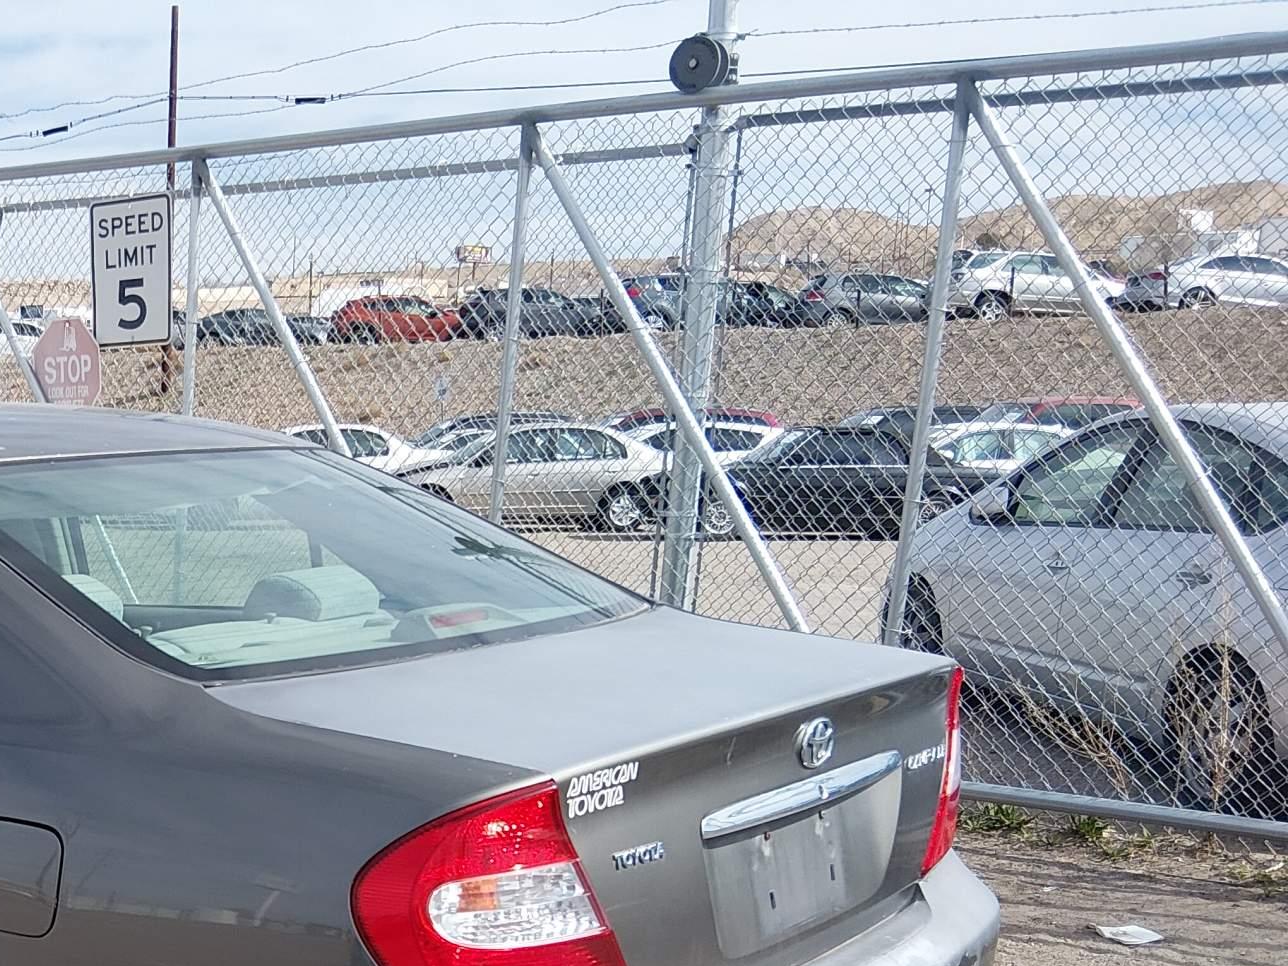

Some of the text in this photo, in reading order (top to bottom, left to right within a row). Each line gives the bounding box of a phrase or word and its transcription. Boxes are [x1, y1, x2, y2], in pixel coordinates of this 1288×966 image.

[98, 212, 163, 238] SPEED
[105, 244, 157, 269] LIMIT
[118, 278, 147, 330] 5
[44, 354, 91, 384] STOP
[48, 384, 89, 398] LOOK OUT FOR
[567, 762, 639, 798] AMERICAN
[567, 785, 624, 818] TOYOTA
[612, 841, 664, 870] TOYOTA
